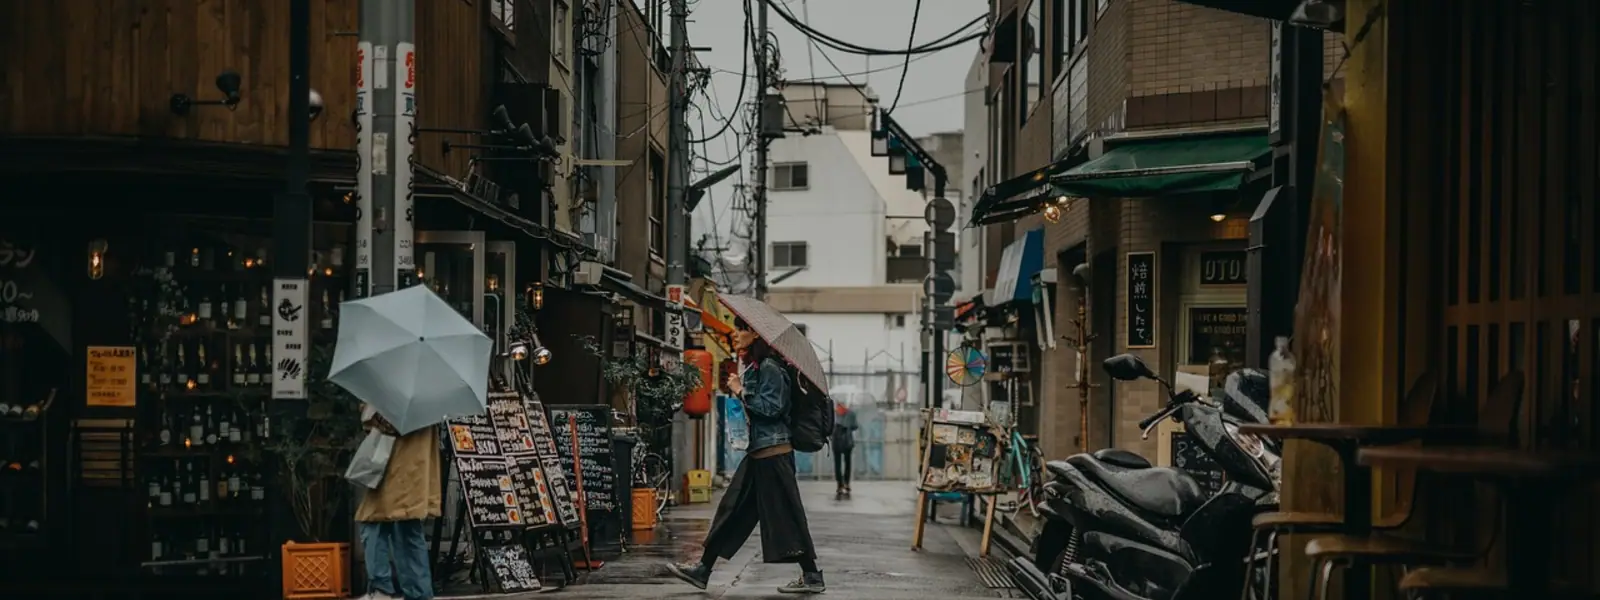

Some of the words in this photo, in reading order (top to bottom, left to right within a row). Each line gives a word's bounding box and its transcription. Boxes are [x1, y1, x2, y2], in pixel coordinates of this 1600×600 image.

[1131, 261, 1148, 339] 焙煎したて
